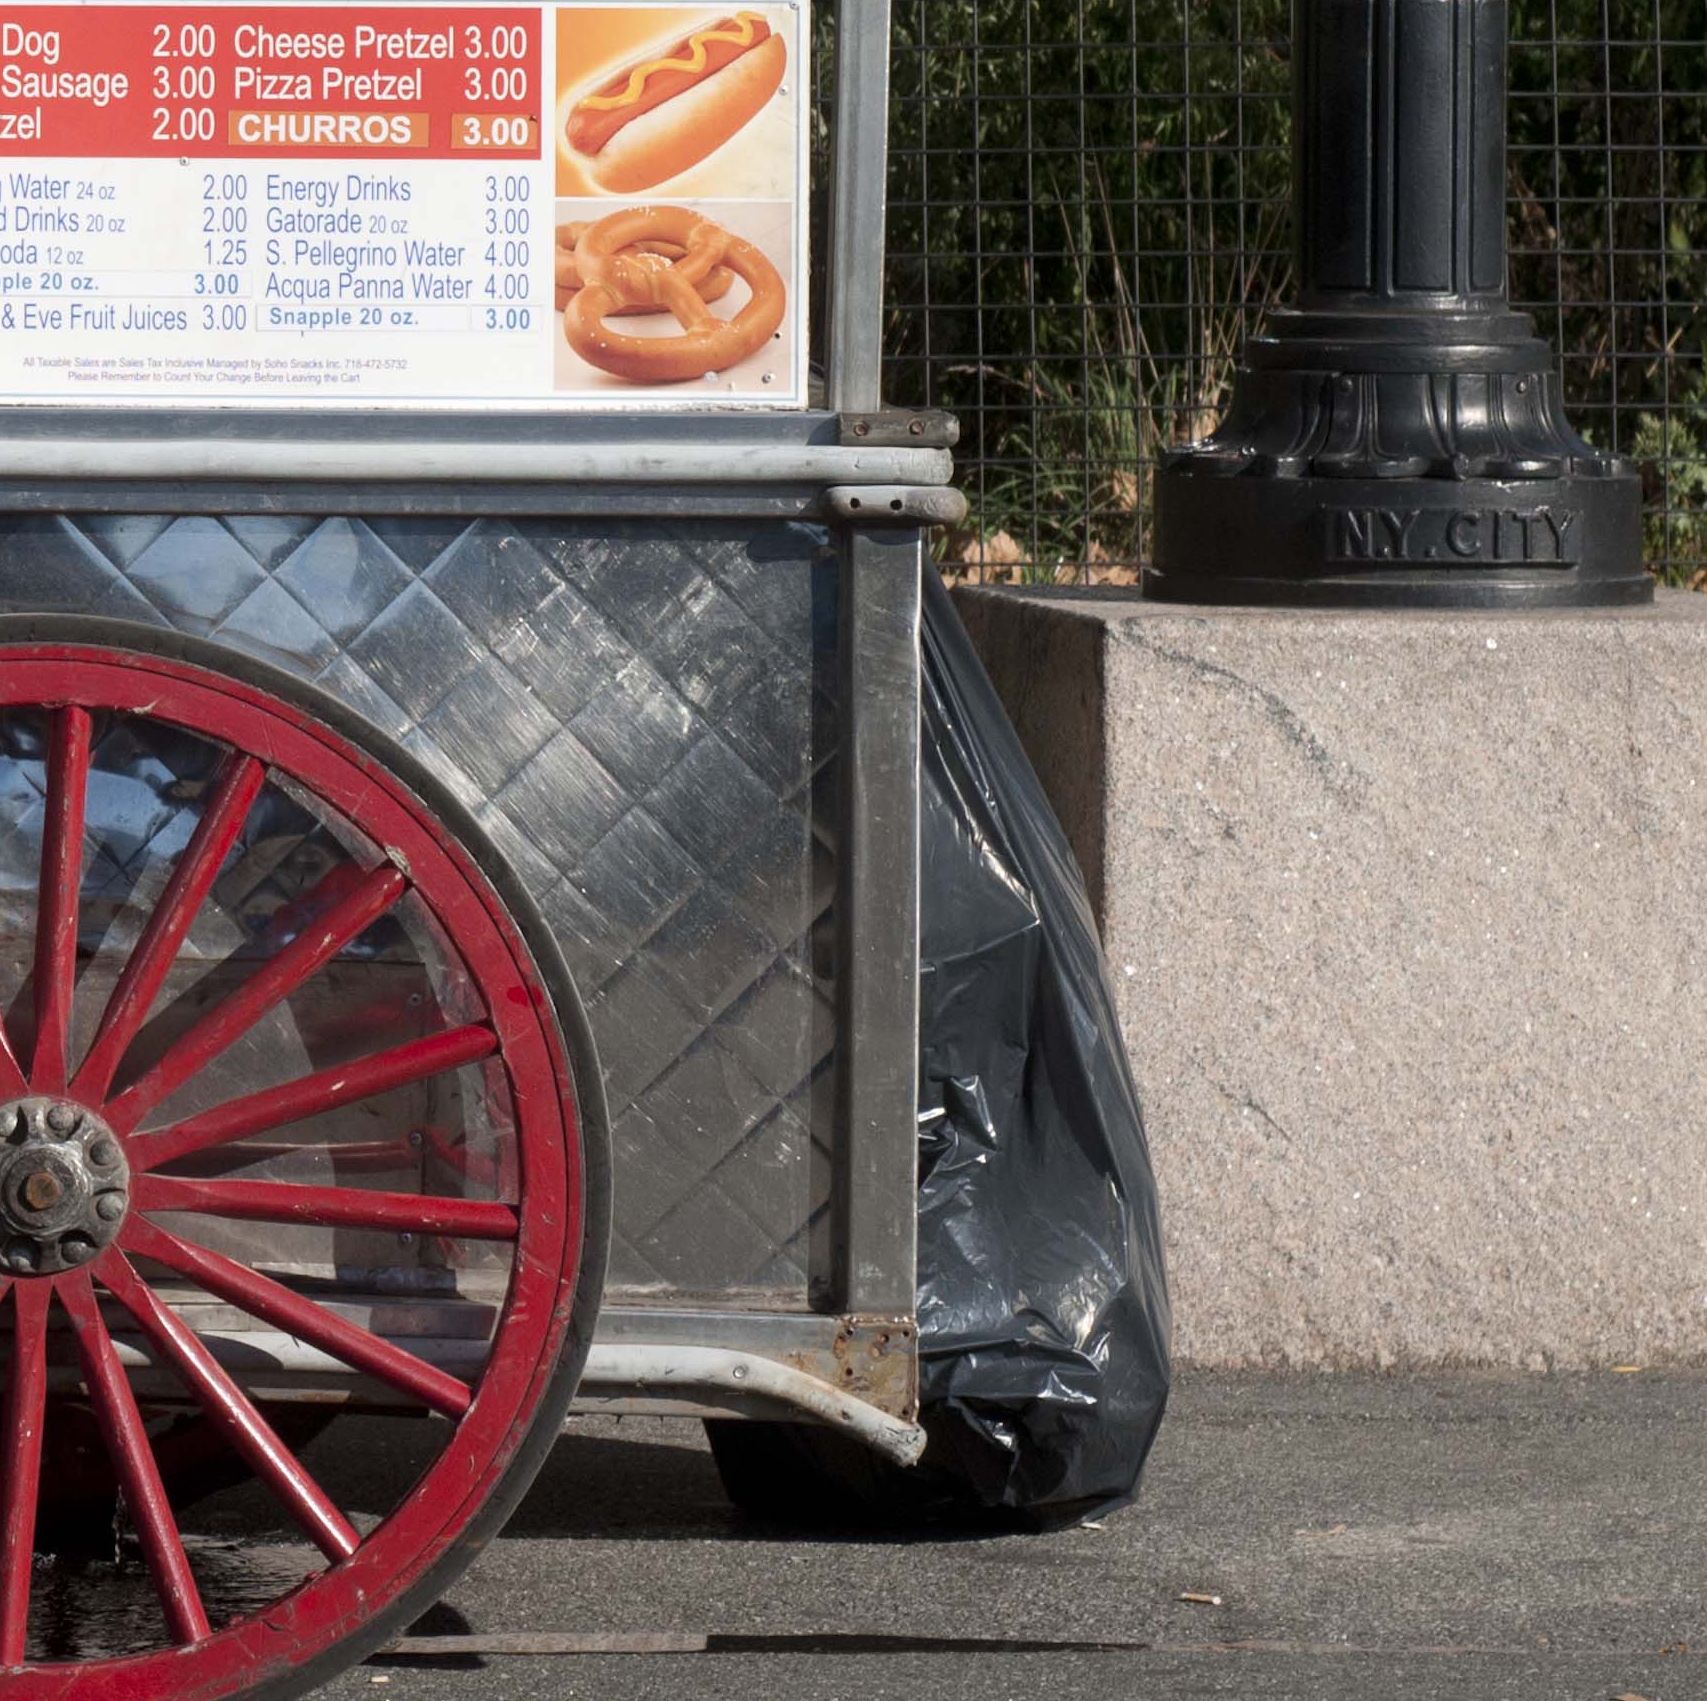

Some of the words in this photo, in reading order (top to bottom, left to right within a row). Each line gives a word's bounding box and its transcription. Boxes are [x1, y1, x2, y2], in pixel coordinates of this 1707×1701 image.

[3, 22, 60, 64] Dog
[153, 24, 215, 57] 2.00
[235, 25, 344, 59] Cheese
[355, 26, 454, 59] Pretzel
[465, 26, 527, 59] 3.00
[2, 64, 128, 106] Sausage
[153, 66, 215, 99] 3.00
[235, 66, 312, 99] Pizza
[323, 67, 422, 100] Pretzel
[465, 68, 527, 100] 3.00
[152, 108, 215, 140] 2.00
[238, 114, 411, 144] CHURROS
[463, 117, 528, 145] 3.00
[10, 173, 70, 199] Water
[77, 182, 94, 199] 24
[99, 185, 115, 200] oz
[203, 174, 247, 200] 2.00
[267, 175, 339, 207] Energy
[347, 175, 411, 201] Drinks
[486, 176, 530, 202] 3.00
[15, 206, 79, 232] Drinks
[86, 214, 104, 232] 20
[108, 218, 125, 232] oz
[203, 207, 247, 232] 2.00
[266, 207, 361, 233] Gatorade
[369, 215, 387, 234] 20
[391, 220, 408, 234] oz
[486, 208, 530, 234] 3.00
[47, 247, 62, 264] 12
[67, 250, 83, 264] oz
[205, 240, 247, 265] 1.25
[266, 239, 286, 266] S.
[295, 240, 396, 273] Pellegrino
[404, 240, 465, 267] Water
[484, 241, 529, 267] 4.00
[40, 273, 62, 290] 20
[71, 275, 99, 290] oz.
[195, 274, 239, 294] 3.00
[265, 272, 330, 305] Acqua
[339, 273, 403, 299] Panna
[412, 273, 473, 299] Water
[484, 274, 529, 300] 4.00
[2, 304, 15, 329] &
[25, 304, 62, 329] Eve
[71, 304, 115, 330] Fruit
[123, 304, 187, 330] Juices
[203, 304, 247, 331] 3.00
[270, 307, 352, 329] Snapple
[360, 308, 382, 325] 20
[390, 310, 418, 325] oz.
[486, 309, 530, 330] 3.00
[1446, 508, 1574, 560] CITY
